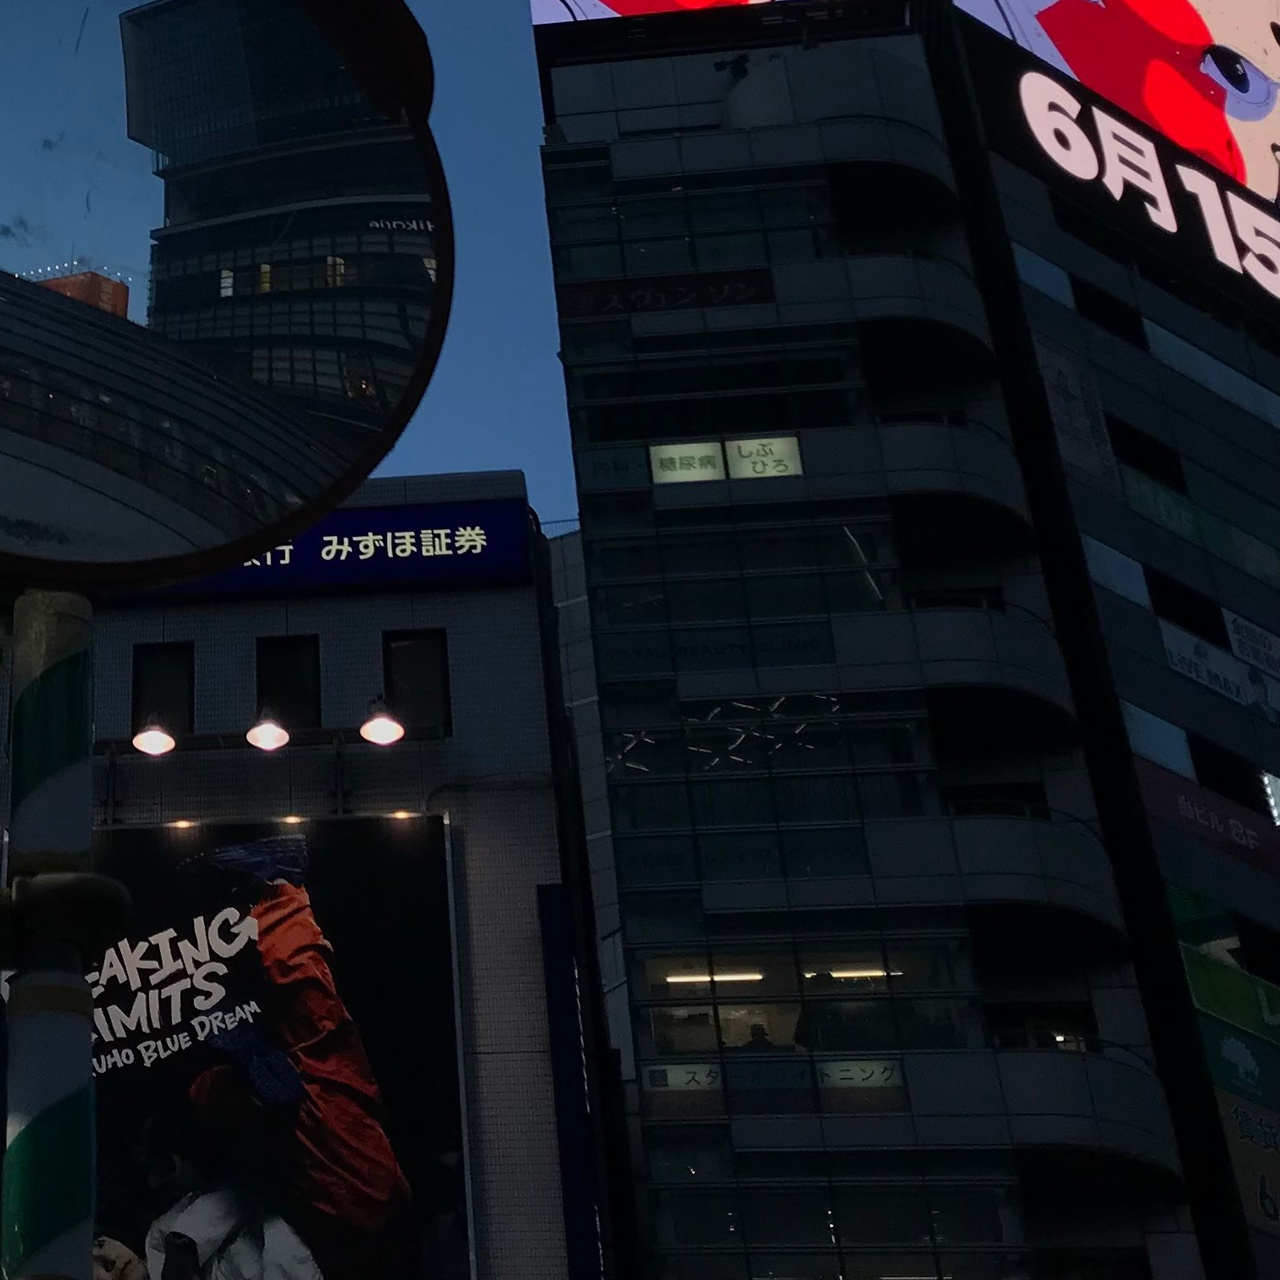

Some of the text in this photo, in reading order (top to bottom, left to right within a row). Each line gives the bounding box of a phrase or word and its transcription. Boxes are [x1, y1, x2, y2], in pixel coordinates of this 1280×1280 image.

[736, 443, 775, 459] しぶ
[752, 459, 790, 475] ひろ
[243, 525, 488, 568] 行 みずほ証券
[91, 961, 229, 1043] IMITS
[92, 1000, 262, 1077] UHO BLUE DREAM
